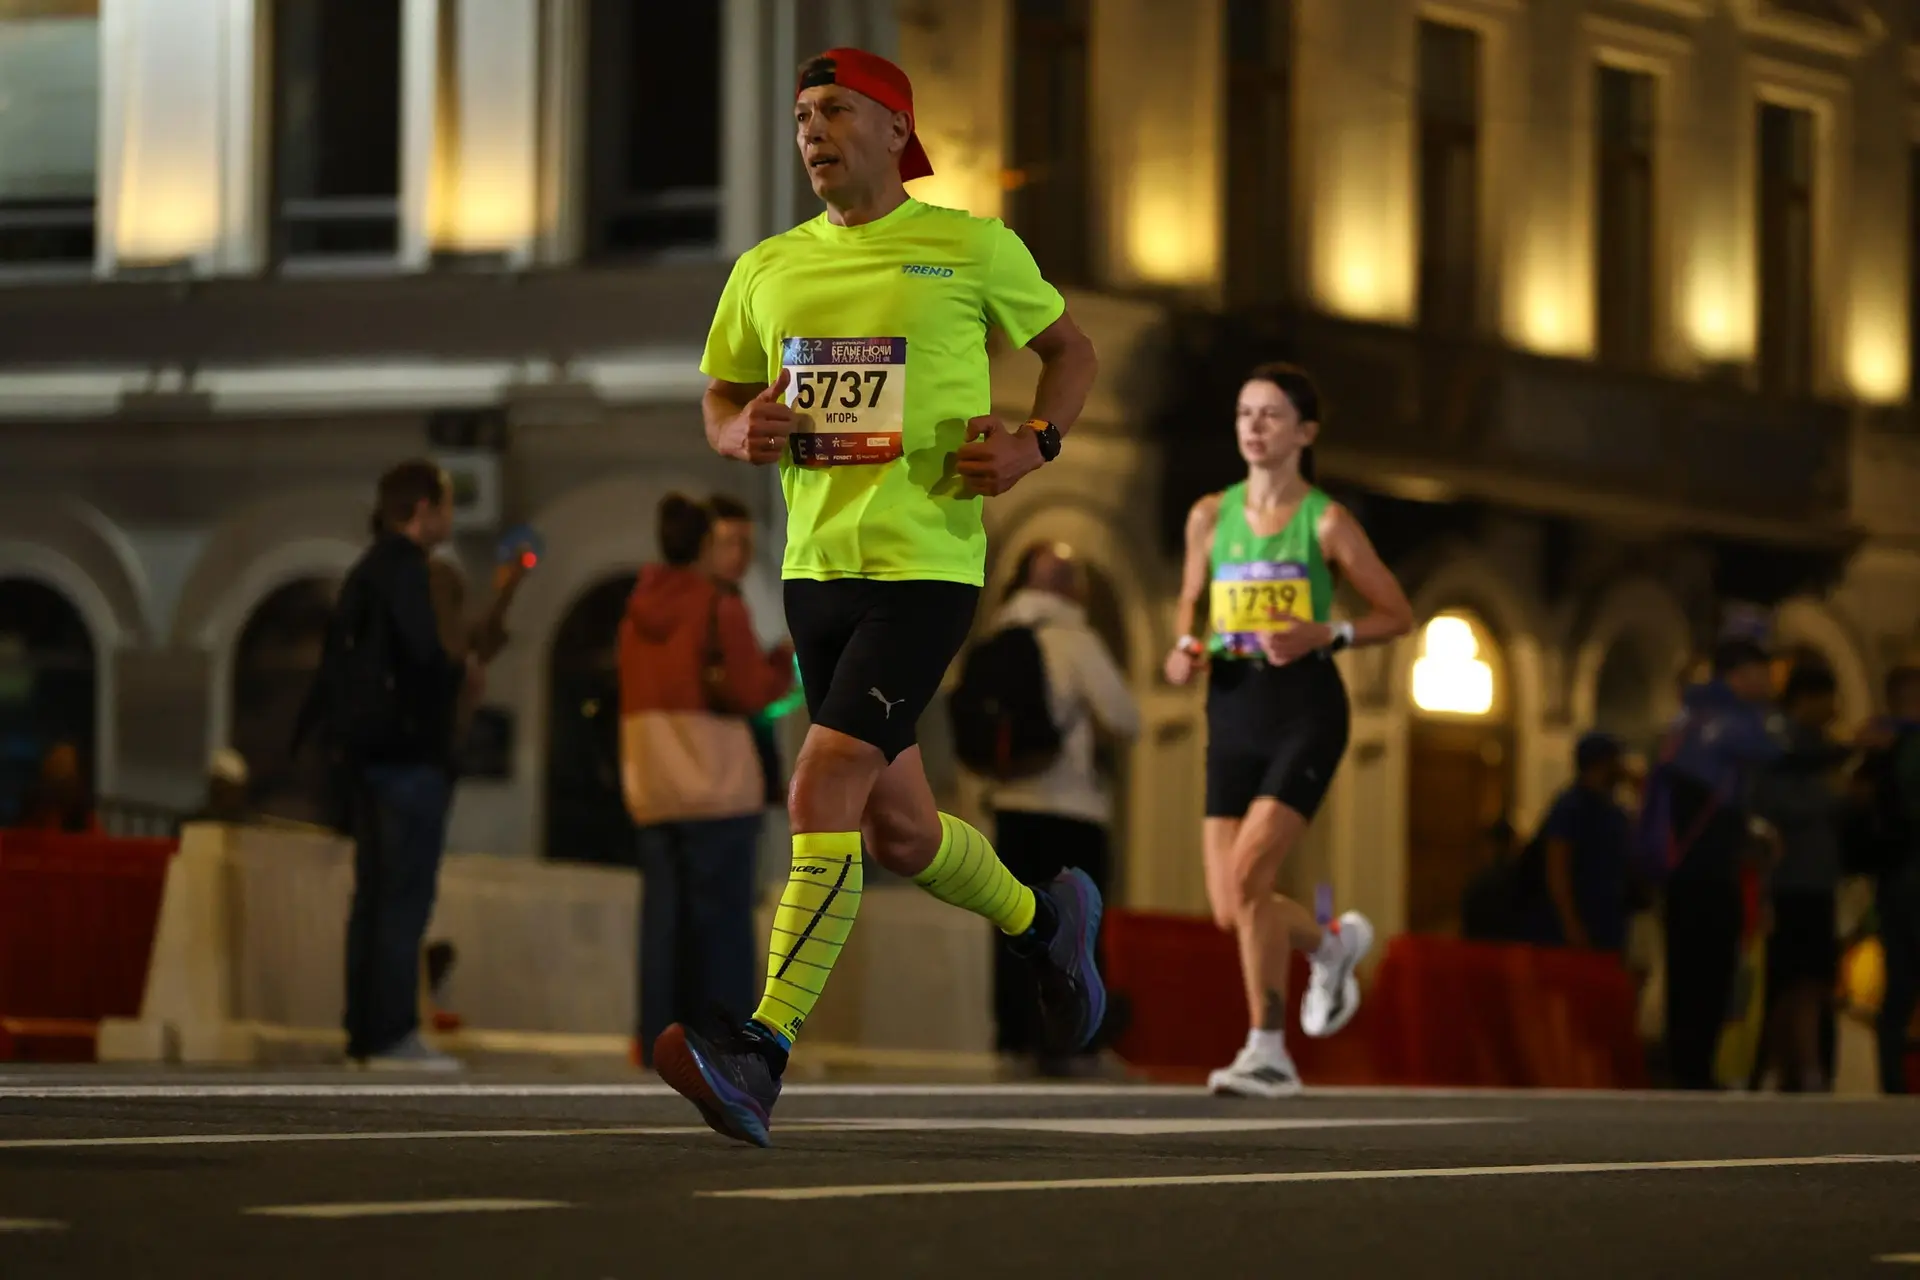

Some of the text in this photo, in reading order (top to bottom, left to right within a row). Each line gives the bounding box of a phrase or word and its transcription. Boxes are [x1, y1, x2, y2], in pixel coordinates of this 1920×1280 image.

[902, 264, 954, 278] TREND
[862, 345, 892, 356] НОЧИ
[831, 354, 881, 363] МАРАФОН
[796, 371, 888, 409] 5737
[826, 412, 858, 423] ИГОРЬ
